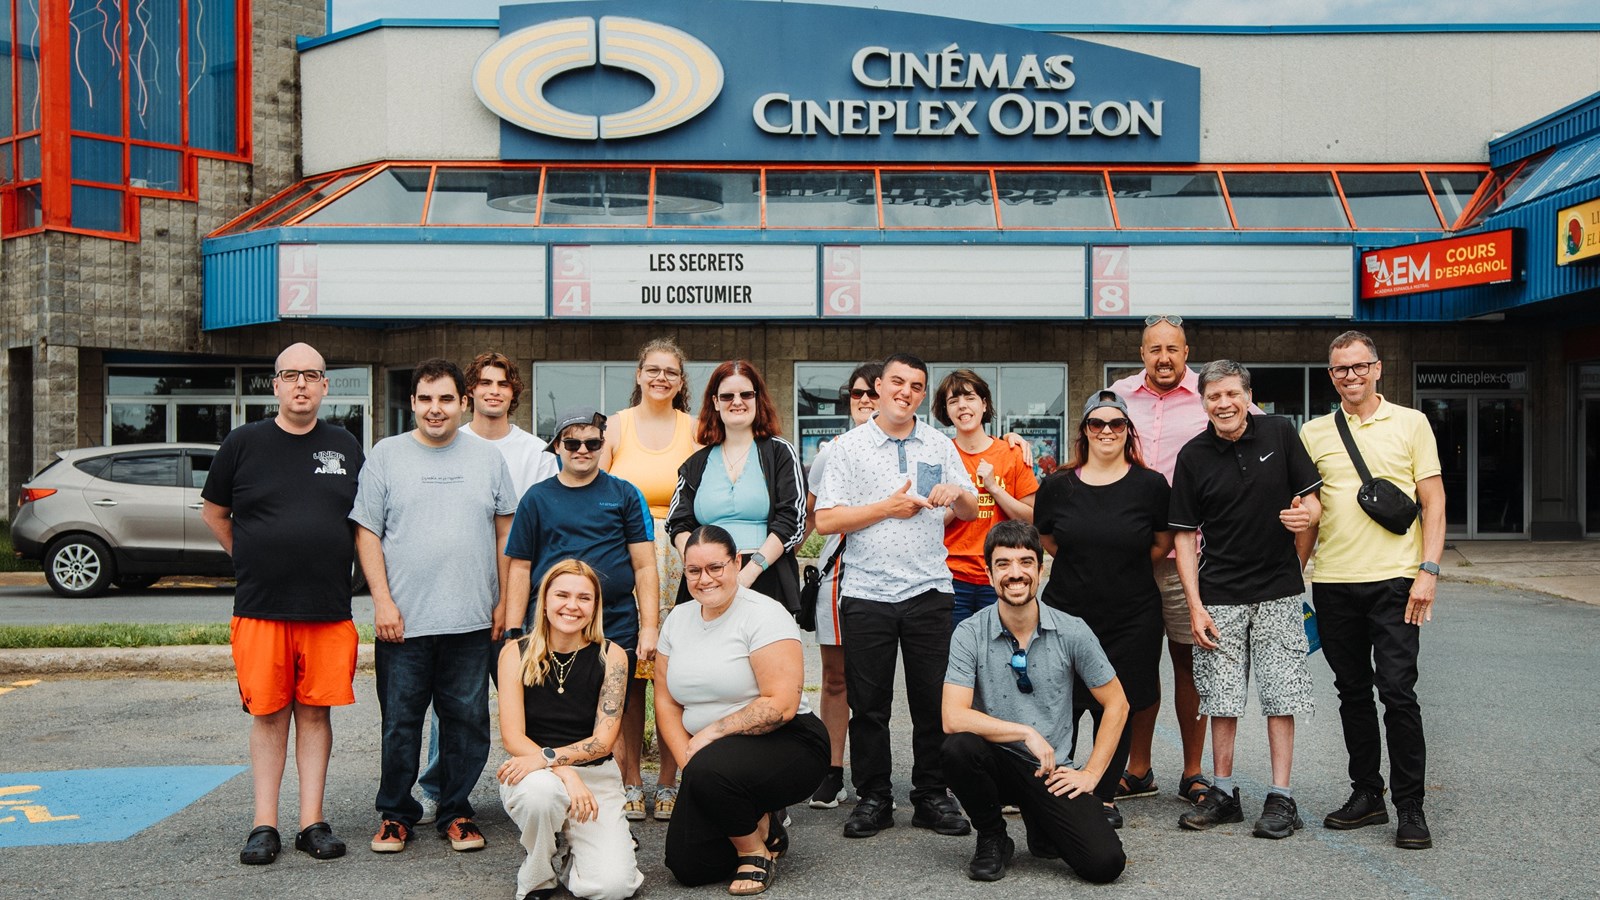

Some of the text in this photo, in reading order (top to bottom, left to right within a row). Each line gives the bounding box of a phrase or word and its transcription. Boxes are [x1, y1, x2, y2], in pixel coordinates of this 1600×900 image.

[851, 42, 1076, 90] CINÉMAS
[752, 92, 1164, 136] CINEPLEX ODEON
[560, 250, 583, 276] 3
[649, 253, 744, 272] LES SECRETS
[832, 249, 854, 276] 5
[1099, 249, 1124, 276] 7
[1446, 242, 1496, 263] COURS
[1373, 251, 1430, 288] AEM
[1435, 259, 1508, 279] D'ESPAGNOL
[287, 284, 310, 311] 2
[558, 285, 587, 312] 4
[641, 285, 752, 304] DU COSTUMIER
[829, 285, 854, 313] 6
[1098, 285, 1125, 312] 8
[251, 377, 275, 388] ww
[1450, 371, 1526, 386] cineplex.com
[977, 495, 993, 504] 979
